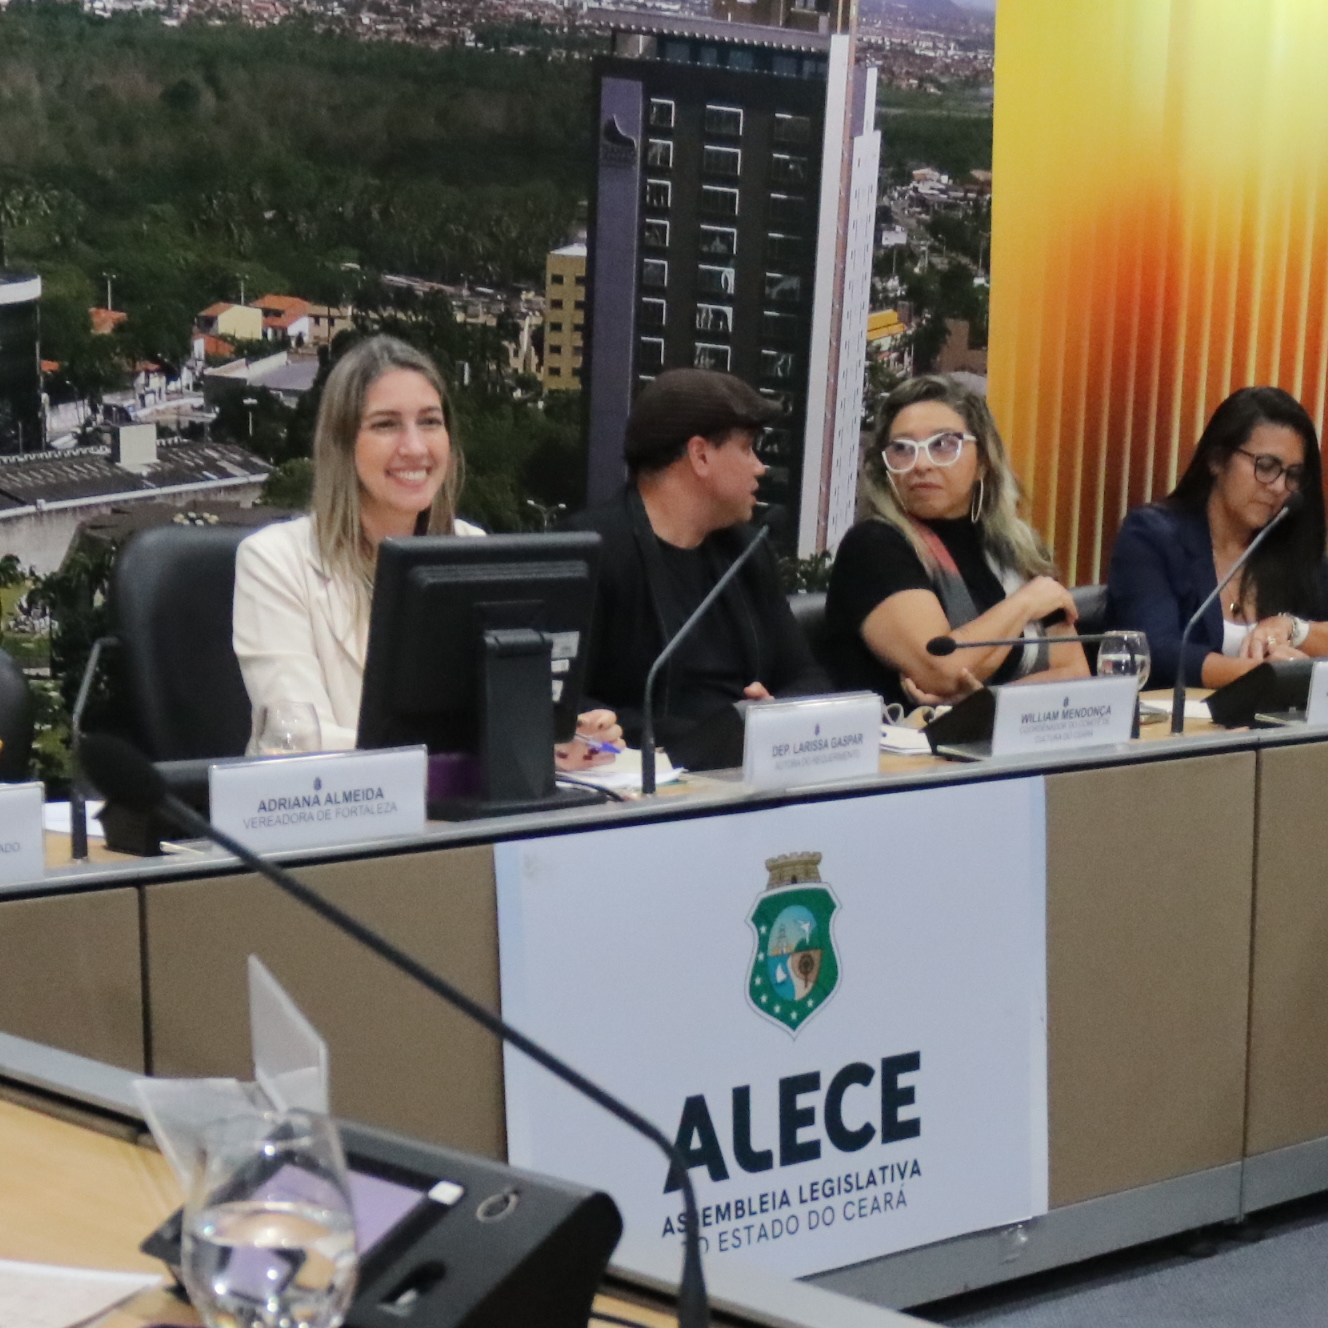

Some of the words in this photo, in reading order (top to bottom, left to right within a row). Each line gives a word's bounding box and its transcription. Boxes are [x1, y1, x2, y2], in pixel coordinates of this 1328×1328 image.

[1021, 710, 1059, 723] WILLIAM
[1061, 705, 1112, 720] MENDONÇA
[793, 739, 828, 753] LARISSA
[831, 734, 863, 748] GASPAR
[257, 794, 321, 813] ADRIANA
[324, 787, 384, 805] ALMEIDA
[243, 812, 314, 829] VEREADORA
[317, 809, 331, 821] DE
[335, 801, 398, 819] FORTALEZA
[663, 1051, 921, 1194] ALECE
[662, 1190, 791, 1237] ASEMBLEIA
[799, 1158, 922, 1204] LEGISLATIVA
[681, 1236, 709, 1254] O
[719, 1215, 799, 1252] ESTADO
[809, 1206, 835, 1231] DO
[843, 1182, 908, 1221] CEARÁ
